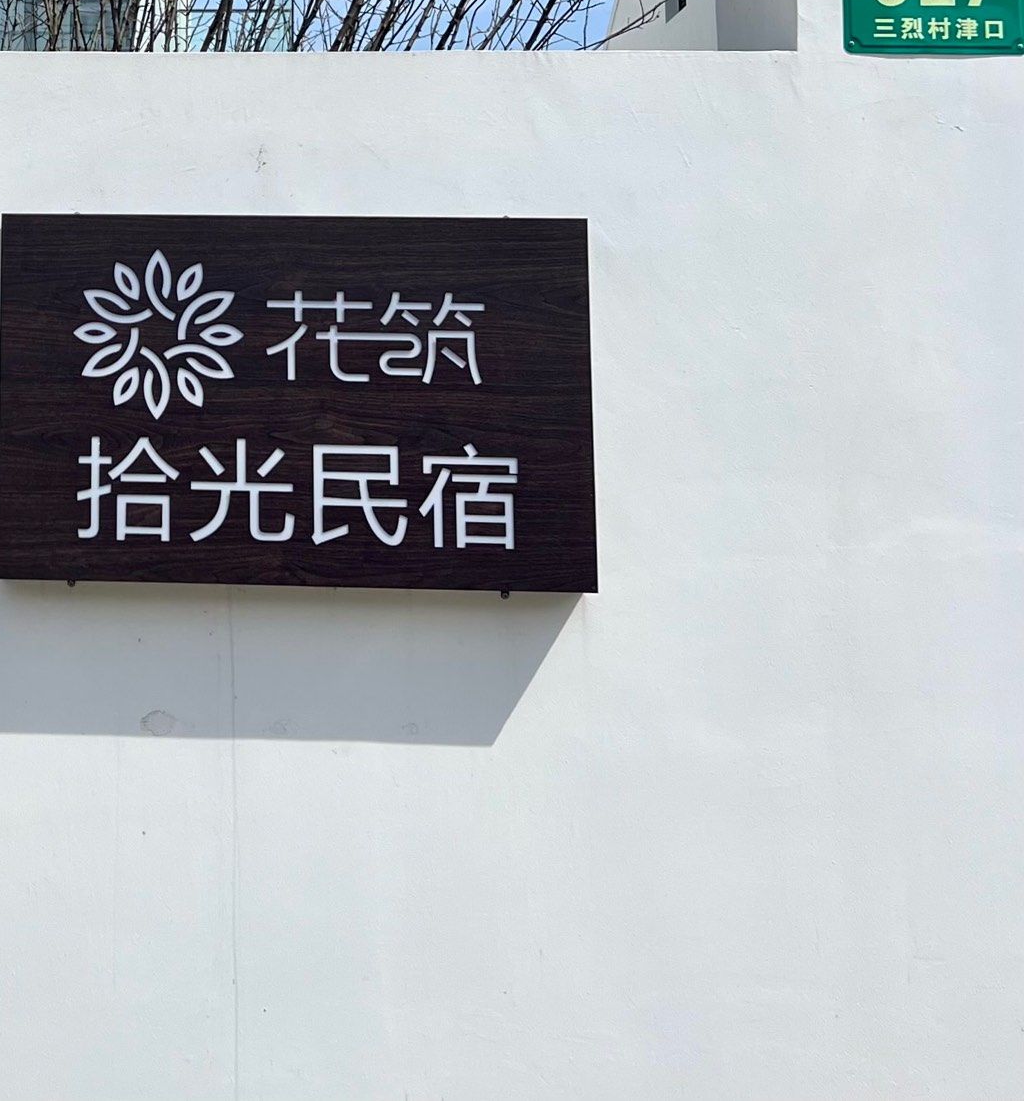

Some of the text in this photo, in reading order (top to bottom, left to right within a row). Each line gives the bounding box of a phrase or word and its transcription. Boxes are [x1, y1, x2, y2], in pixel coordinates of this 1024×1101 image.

[873, 17, 1004, 40] 三烈村津口
[266, 290, 486, 386] 花筑
[77, 436, 519, 551] 拾光民宿
